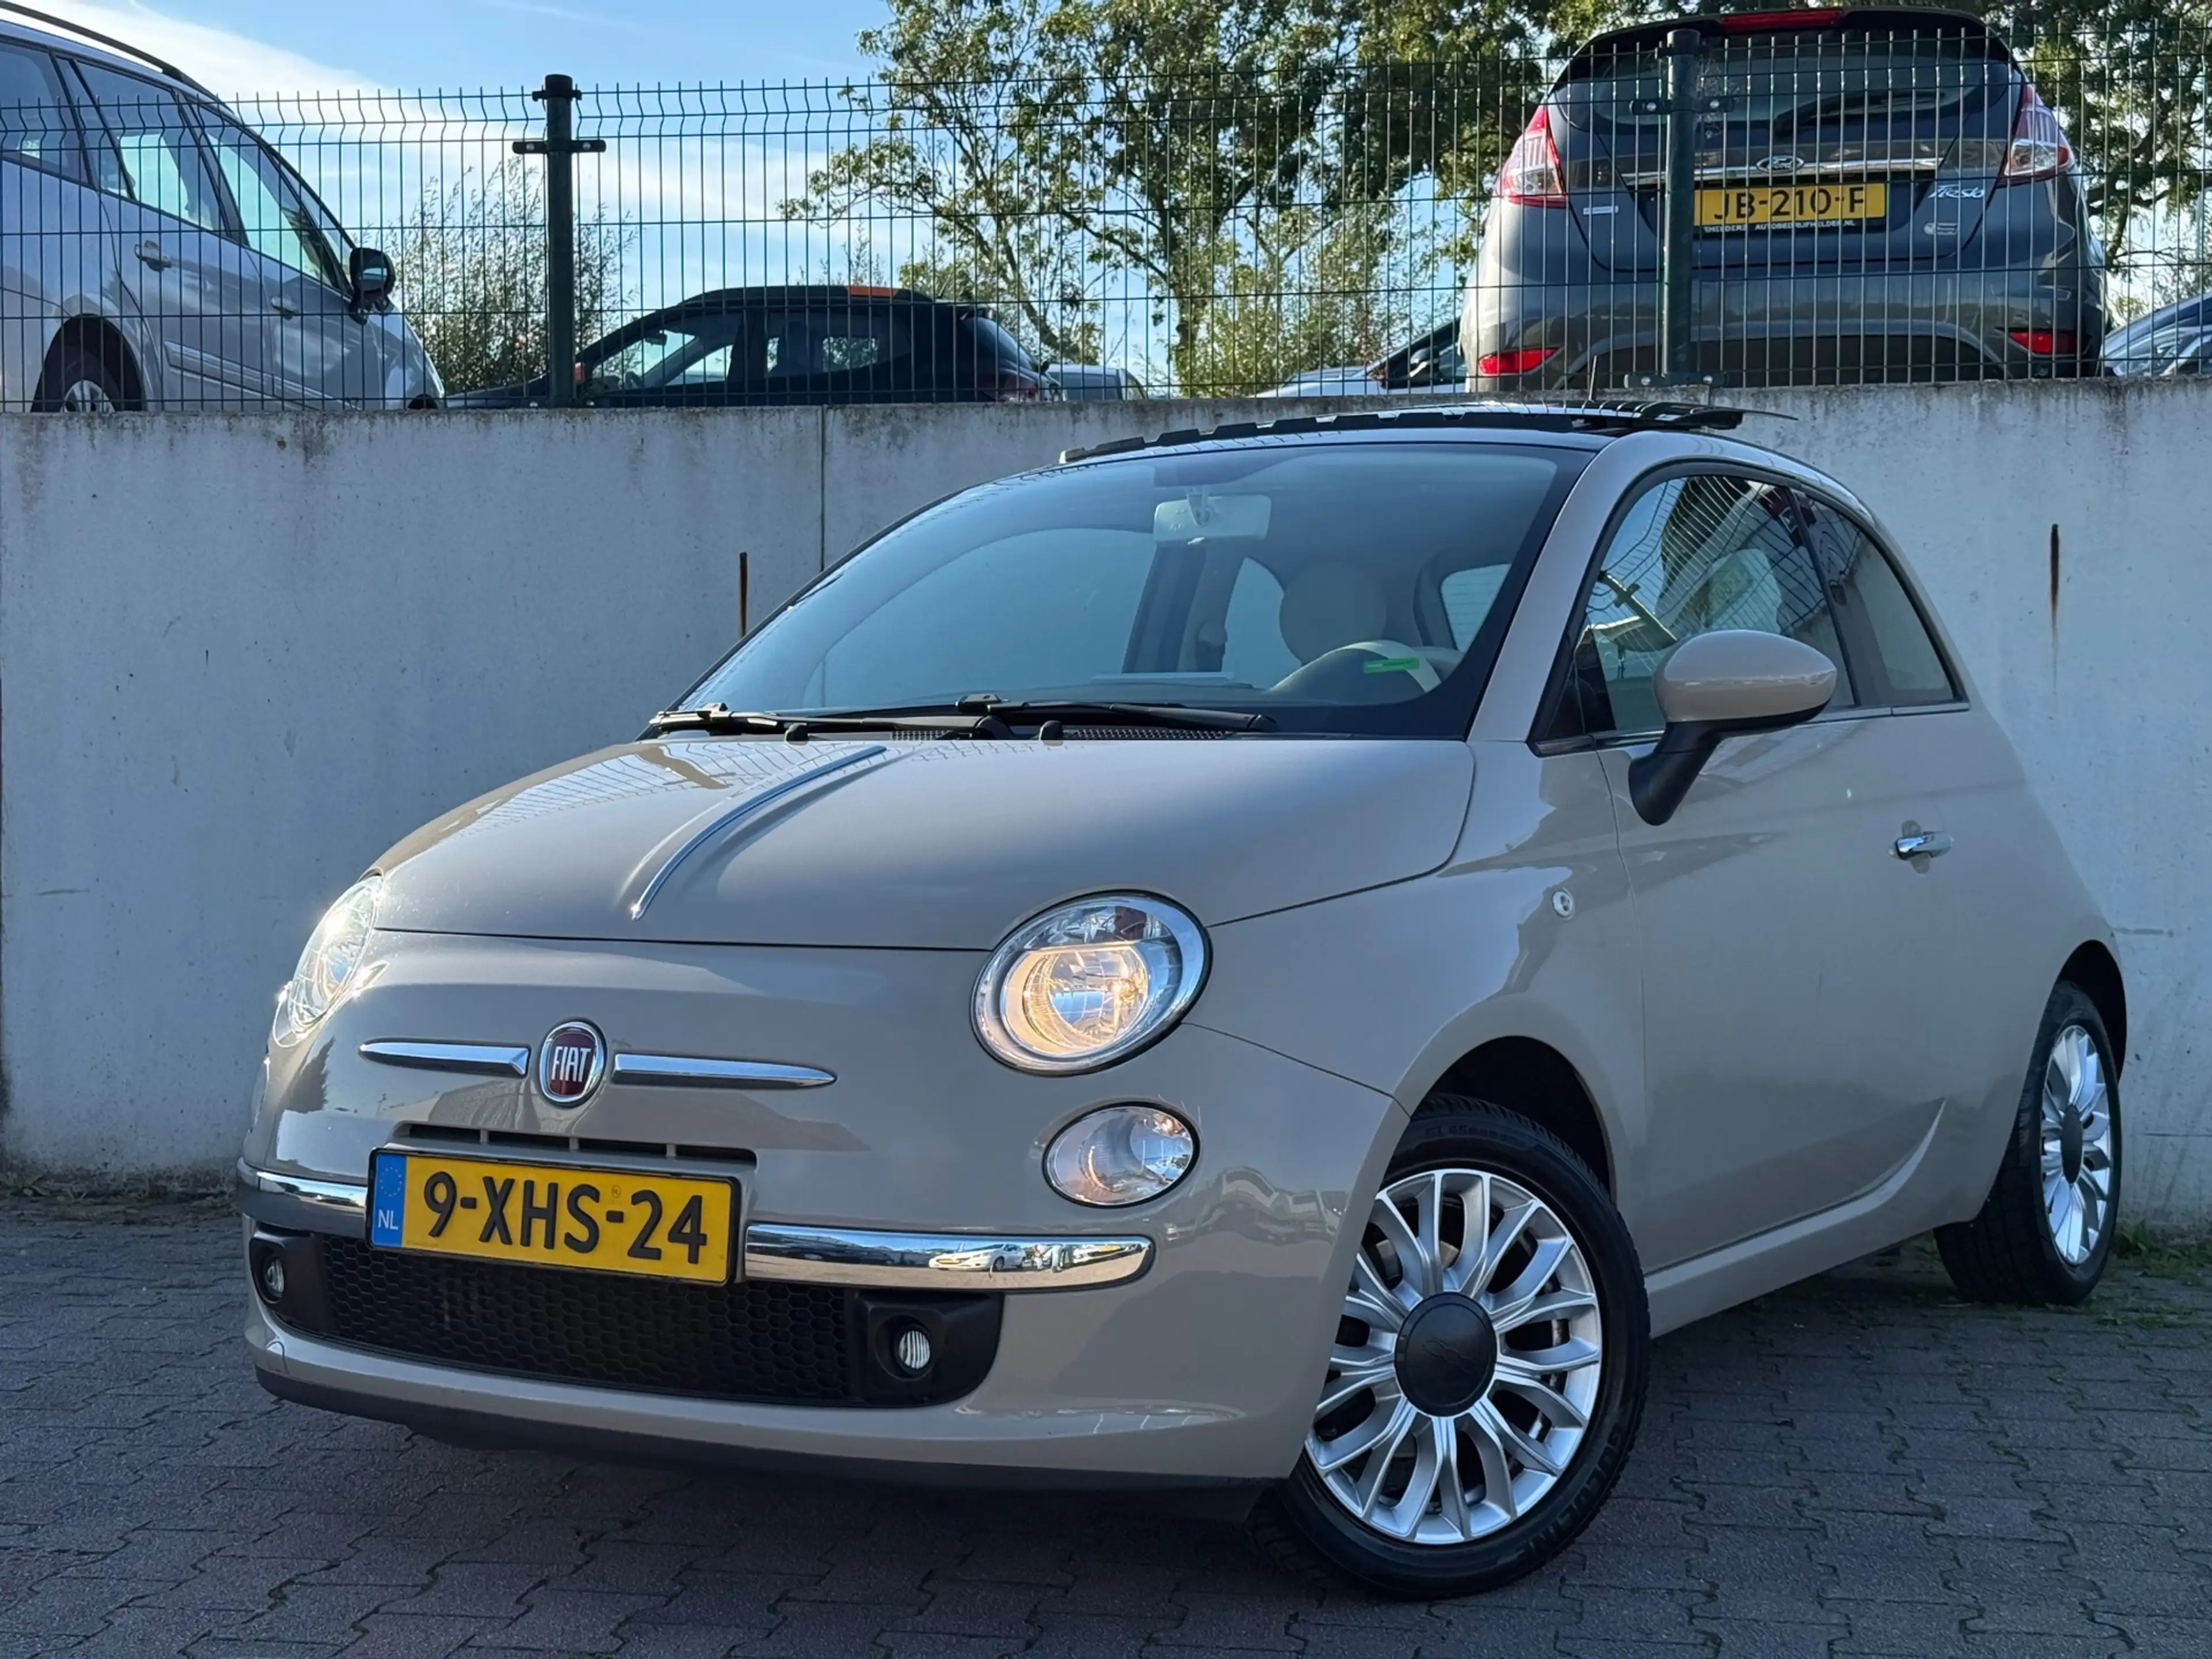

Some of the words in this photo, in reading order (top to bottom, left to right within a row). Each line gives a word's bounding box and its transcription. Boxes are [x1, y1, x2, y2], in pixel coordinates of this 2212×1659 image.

[1714, 187, 1864, 219] JB-210-F
[551, 1046, 592, 1082] FIAT
[378, 1209, 399, 1230] NL
[423, 1171, 707, 1264] 9-XHS-24
